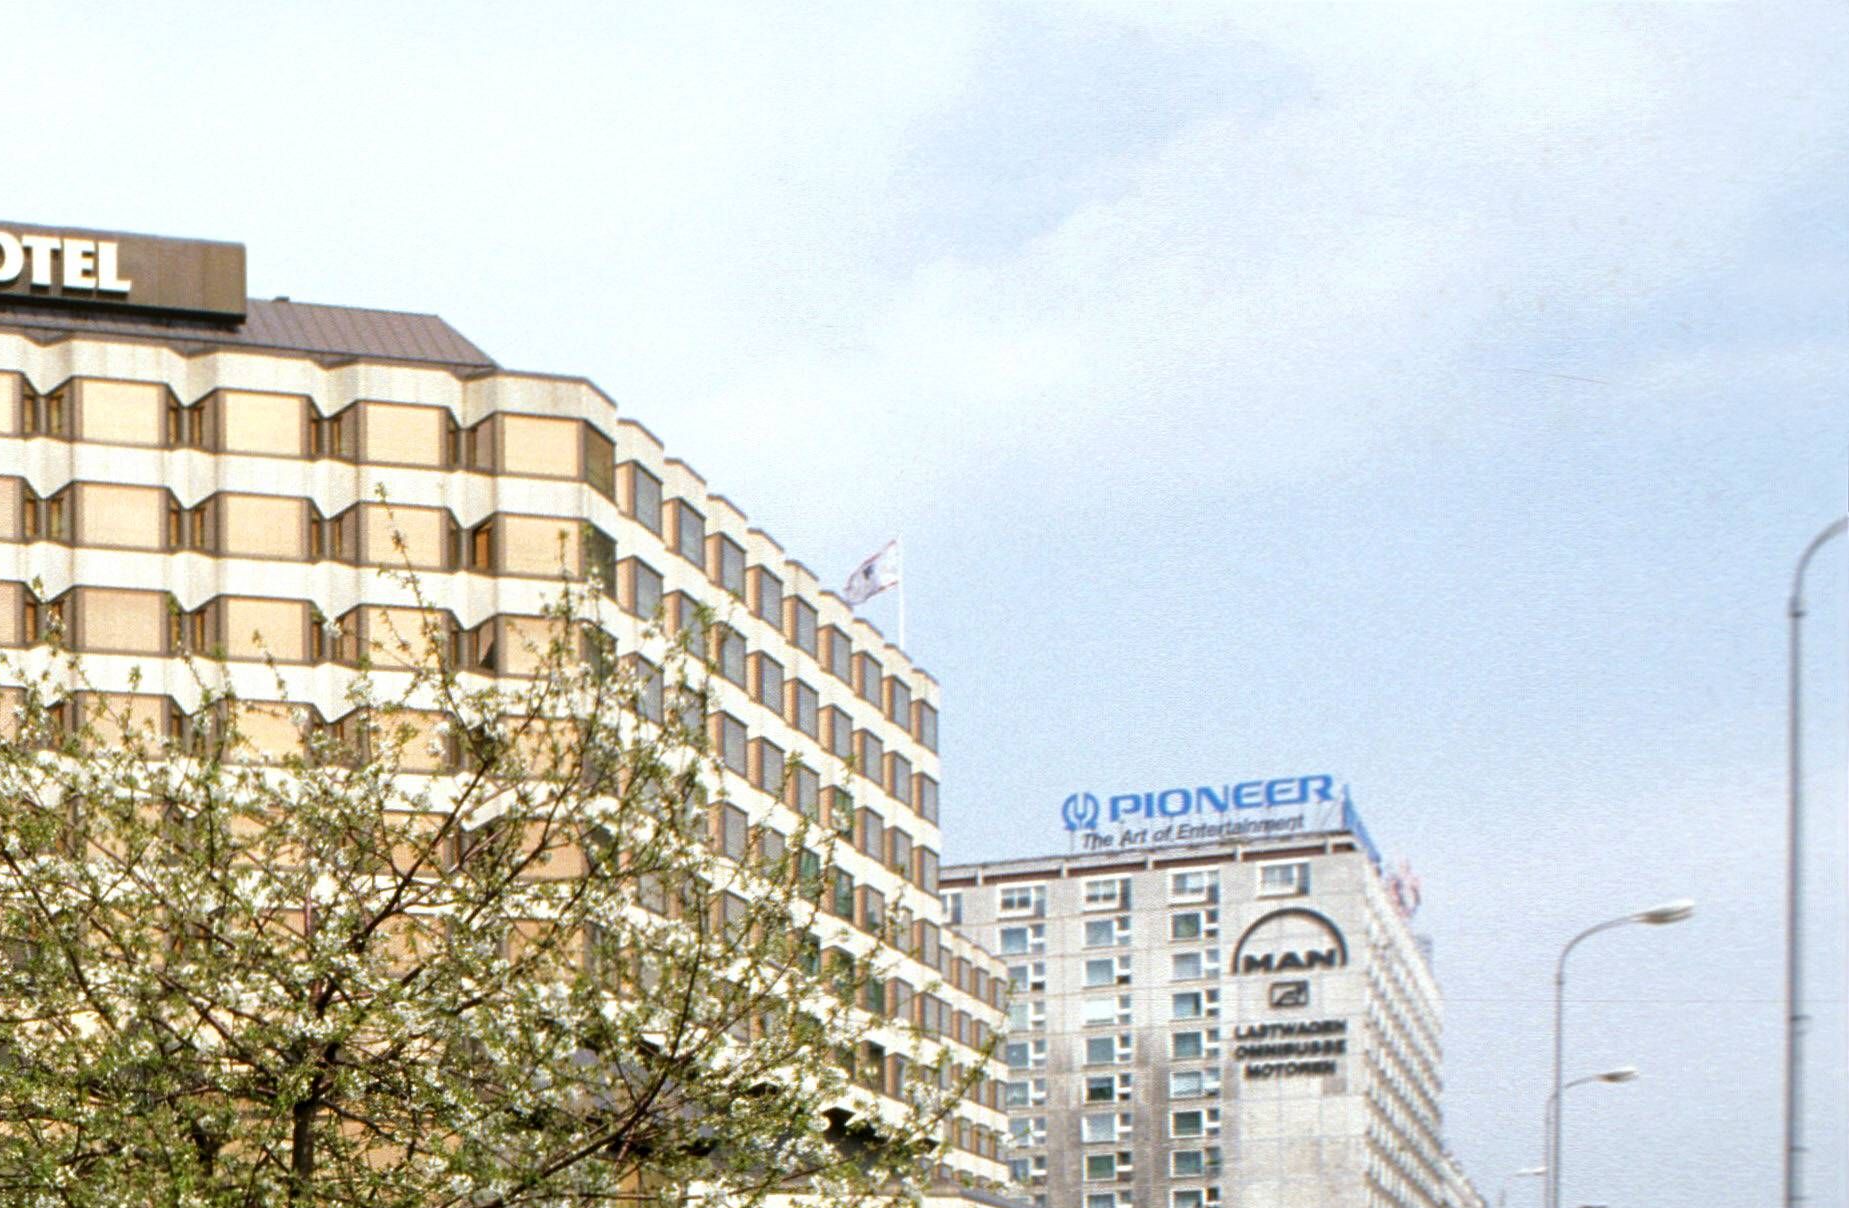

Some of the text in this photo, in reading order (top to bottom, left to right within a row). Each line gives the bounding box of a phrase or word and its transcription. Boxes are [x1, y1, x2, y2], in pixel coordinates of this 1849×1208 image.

[1109, 774, 1335, 822] PIONEER
[1083, 814, 1304, 849] The Art of Entertainment
[1243, 949, 1336, 972] MAN
[1235, 1019, 1346, 1039] LASTWAGEN
[1244, 1060, 1336, 1079] MOTOREN
